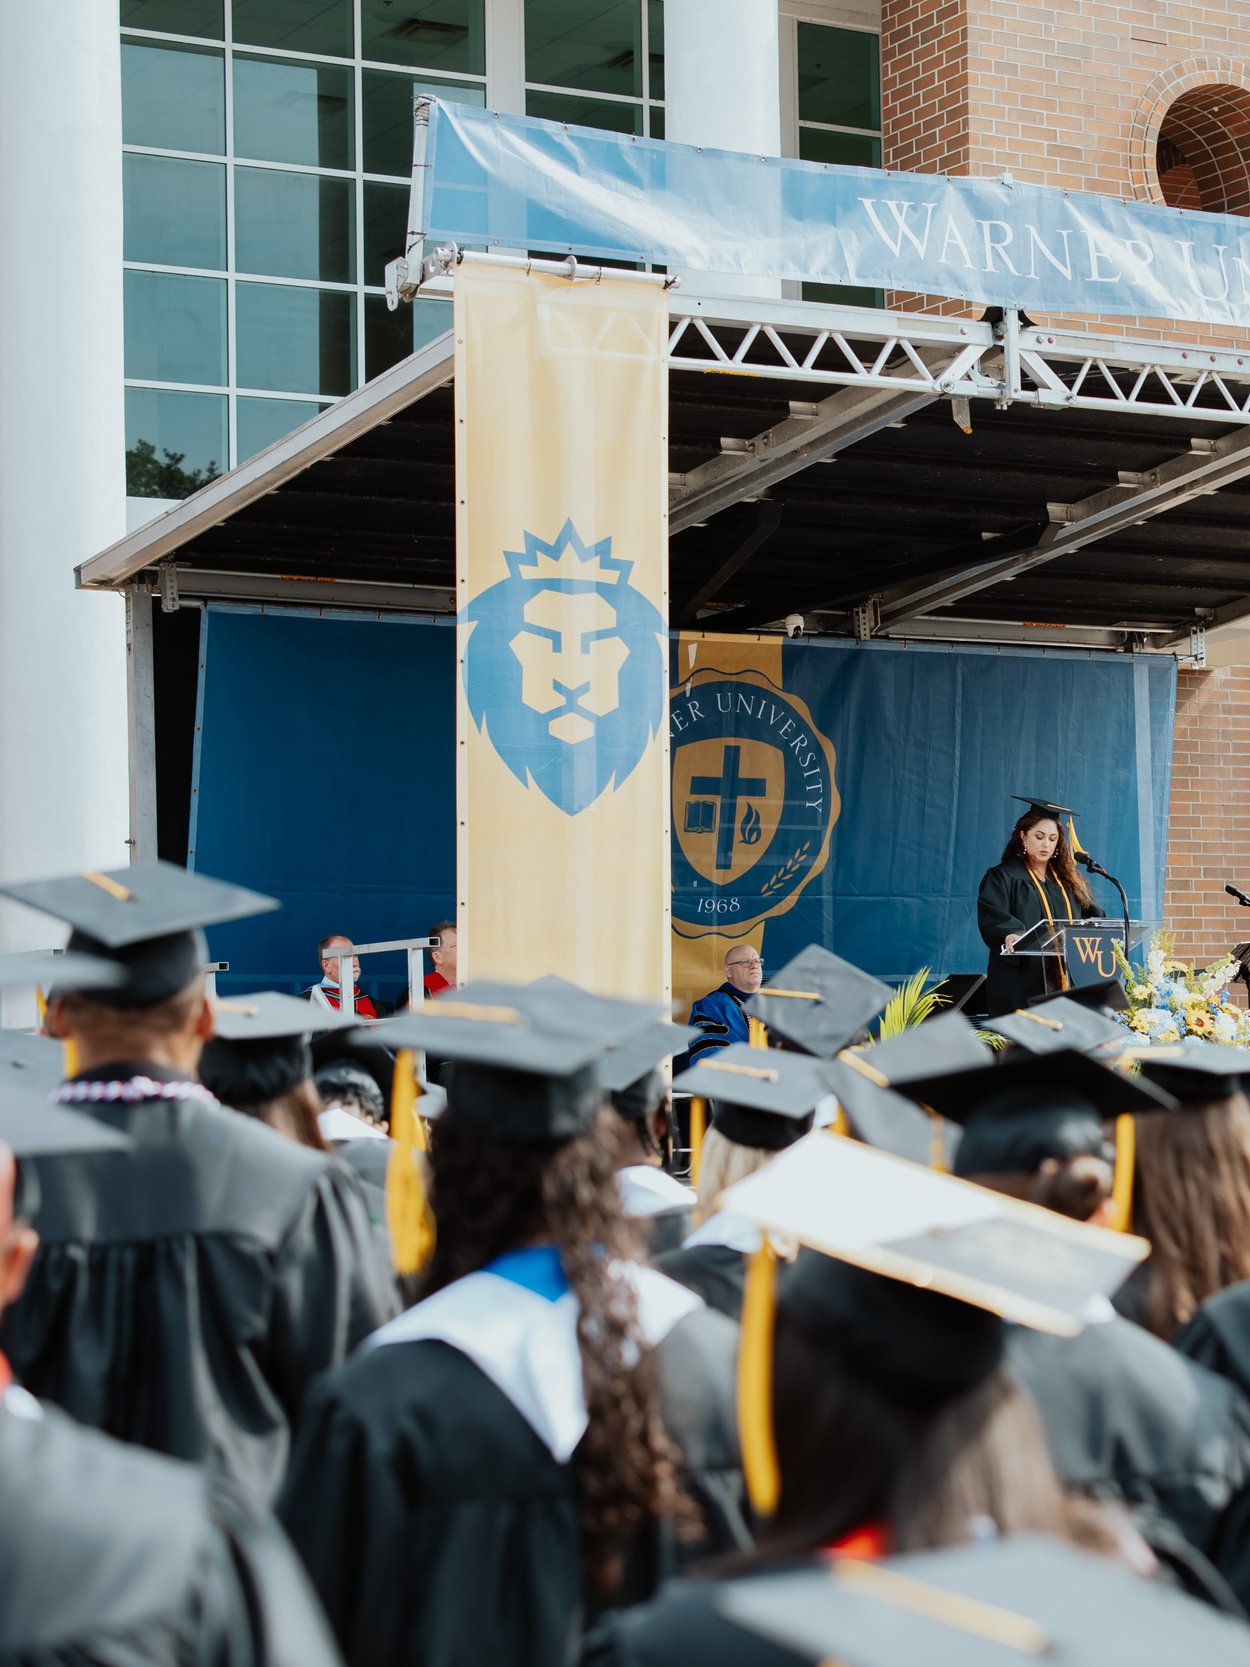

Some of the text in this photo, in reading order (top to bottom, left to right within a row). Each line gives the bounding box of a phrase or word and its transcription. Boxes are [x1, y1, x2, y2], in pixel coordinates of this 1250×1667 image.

[858, 197, 1166, 287] WARNER
[716, 692, 824, 814] UNIVERSITY
[697, 897, 741, 914] 1968
[1072, 936, 1117, 978] WU
